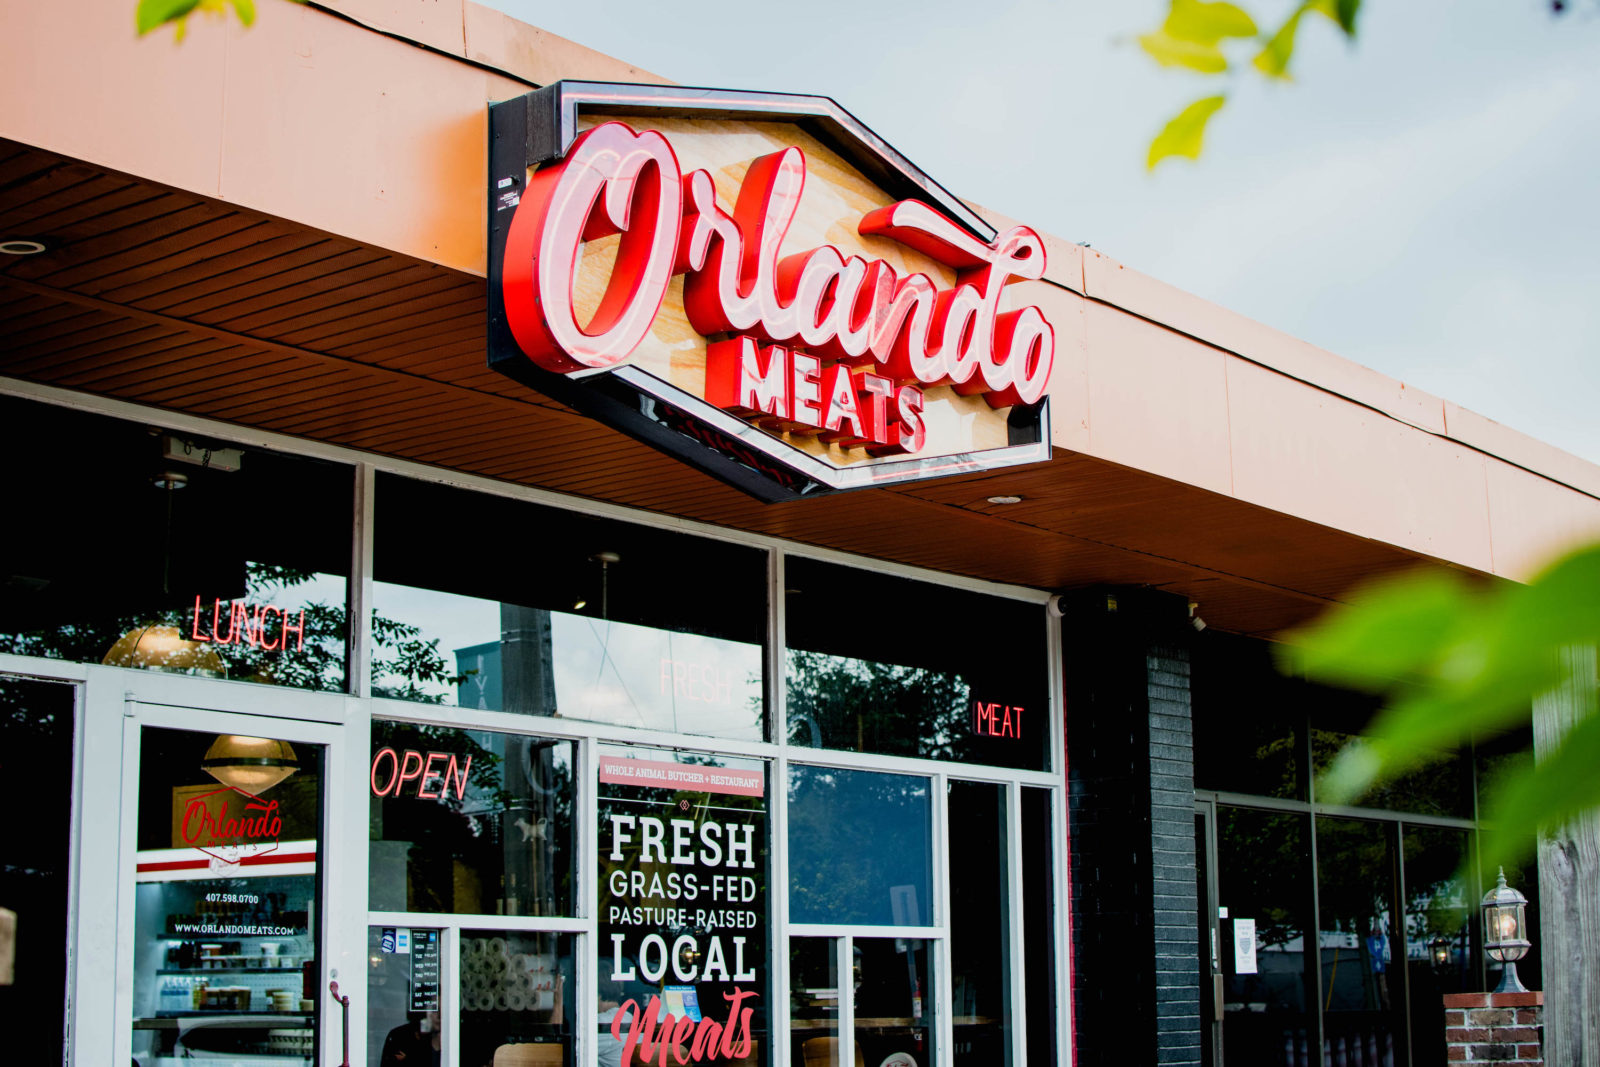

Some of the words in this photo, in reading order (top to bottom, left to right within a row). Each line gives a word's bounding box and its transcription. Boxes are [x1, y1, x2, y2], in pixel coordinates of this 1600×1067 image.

[503, 120, 1055, 407] Orlando
[706, 334, 926, 457] MEATS
[192, 594, 305, 653] LUNCH
[659, 657, 735, 706] FRESH
[976, 700, 1024, 740] MEAT
[370, 747, 472, 802] OPEN
[604, 764, 634, 778] WHOLE
[635, 766, 667, 781] ANIMAL
[667, 769, 704, 784] BUTCHER
[711, 774, 759, 789] RESTAURANT
[181, 799, 282, 844] Orlando
[609, 814, 756, 869] FRESH
[207, 841, 258, 851] MEATS
[205, 892, 259, 905] 407.598.0700
[609, 870, 756, 903] GRASS-FED
[174, 923, 294, 936] WWW.ORLANDOMEATS.COM
[609, 906, 757, 929] PASTURE-RAISED
[610, 932, 756, 983] LOCAL
[610, 986, 760, 1067] Meats
